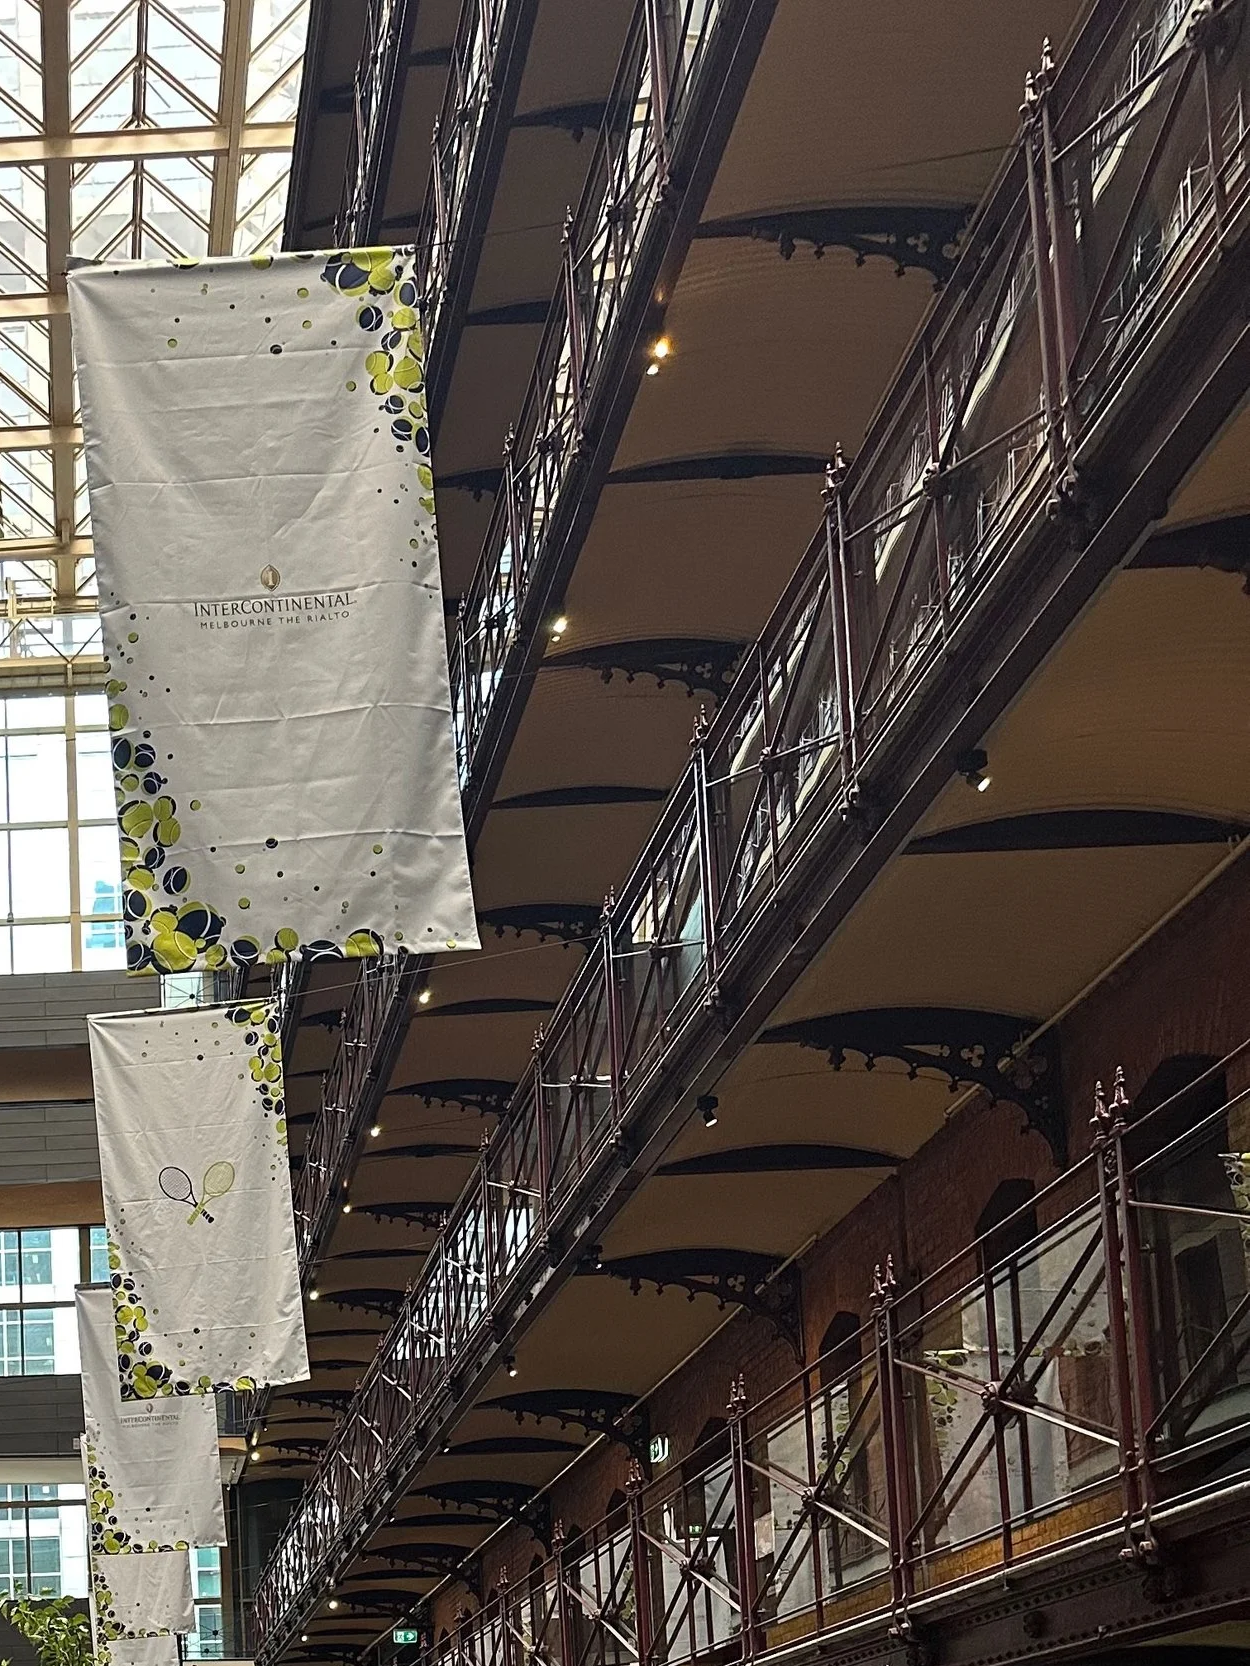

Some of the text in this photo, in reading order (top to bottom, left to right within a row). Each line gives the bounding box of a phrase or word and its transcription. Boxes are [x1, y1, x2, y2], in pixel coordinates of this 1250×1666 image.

[194, 592, 355, 617] INTERCONTINENTAL
[200, 610, 350, 630] MELBOURNE THE RIALTO
